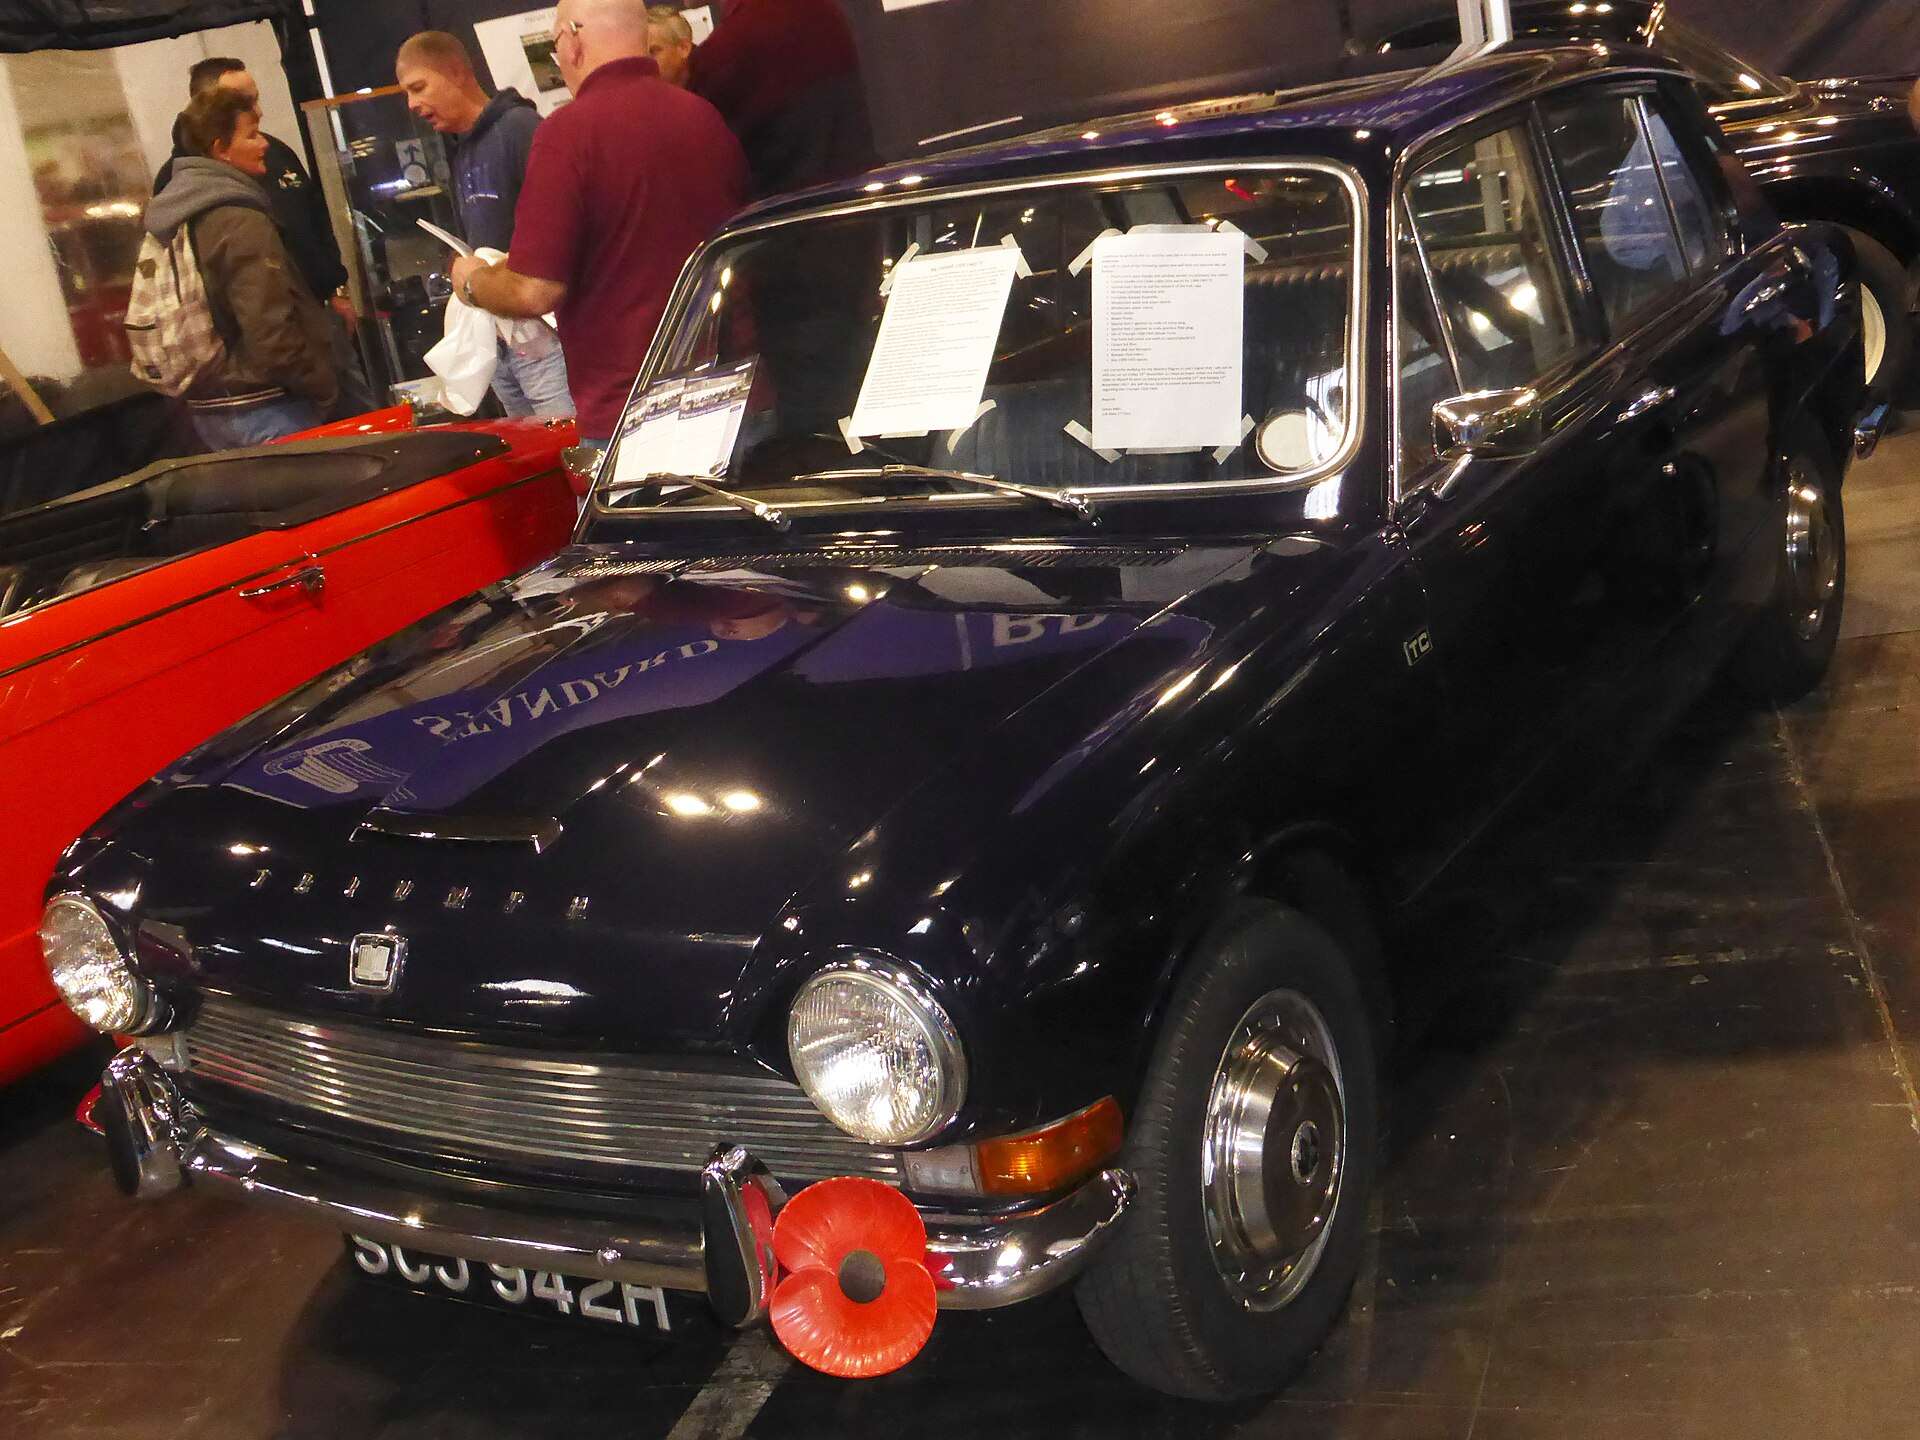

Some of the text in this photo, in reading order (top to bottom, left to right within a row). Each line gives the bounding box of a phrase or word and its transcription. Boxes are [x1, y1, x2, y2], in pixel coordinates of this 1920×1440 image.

[250, 869, 590, 921] TRIUMPH
[351, 1233, 671, 1331] SCJ 942H
